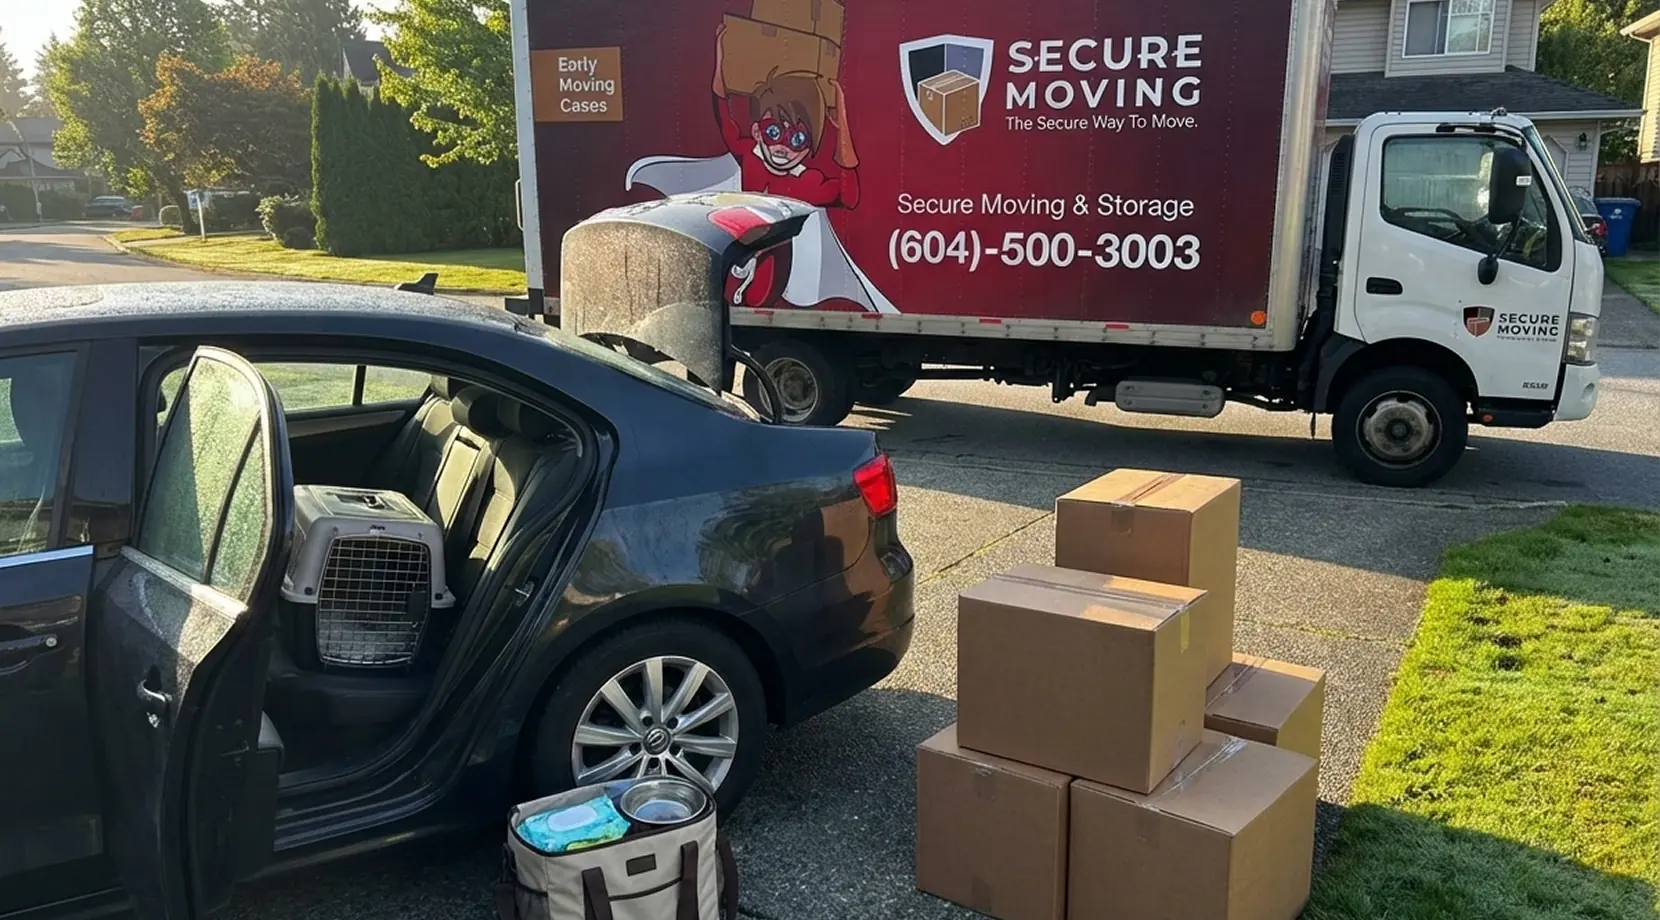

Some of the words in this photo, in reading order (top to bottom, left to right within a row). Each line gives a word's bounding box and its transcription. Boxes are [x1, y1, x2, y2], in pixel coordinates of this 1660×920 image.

[1008, 34, 1203, 74] SECURE
[559, 78, 615, 95] Moving
[1005, 76, 1202, 111] MOVING
[560, 98, 607, 112] Cases
[1006, 116, 1033, 131] The
[1037, 116, 1088, 131] Secure
[1092, 115, 1125, 132] Way
[1129, 114, 1147, 128] To
[1151, 113, 1198, 129] Move.
[897, 194, 974, 215] Secure
[981, 194, 1065, 220] Moving
[1072, 195, 1089, 215] &
[1097, 194, 1194, 221] Storage
[888, 229, 1201, 272] (604)-500-3003
[1499, 313, 1560, 324] SECURE
